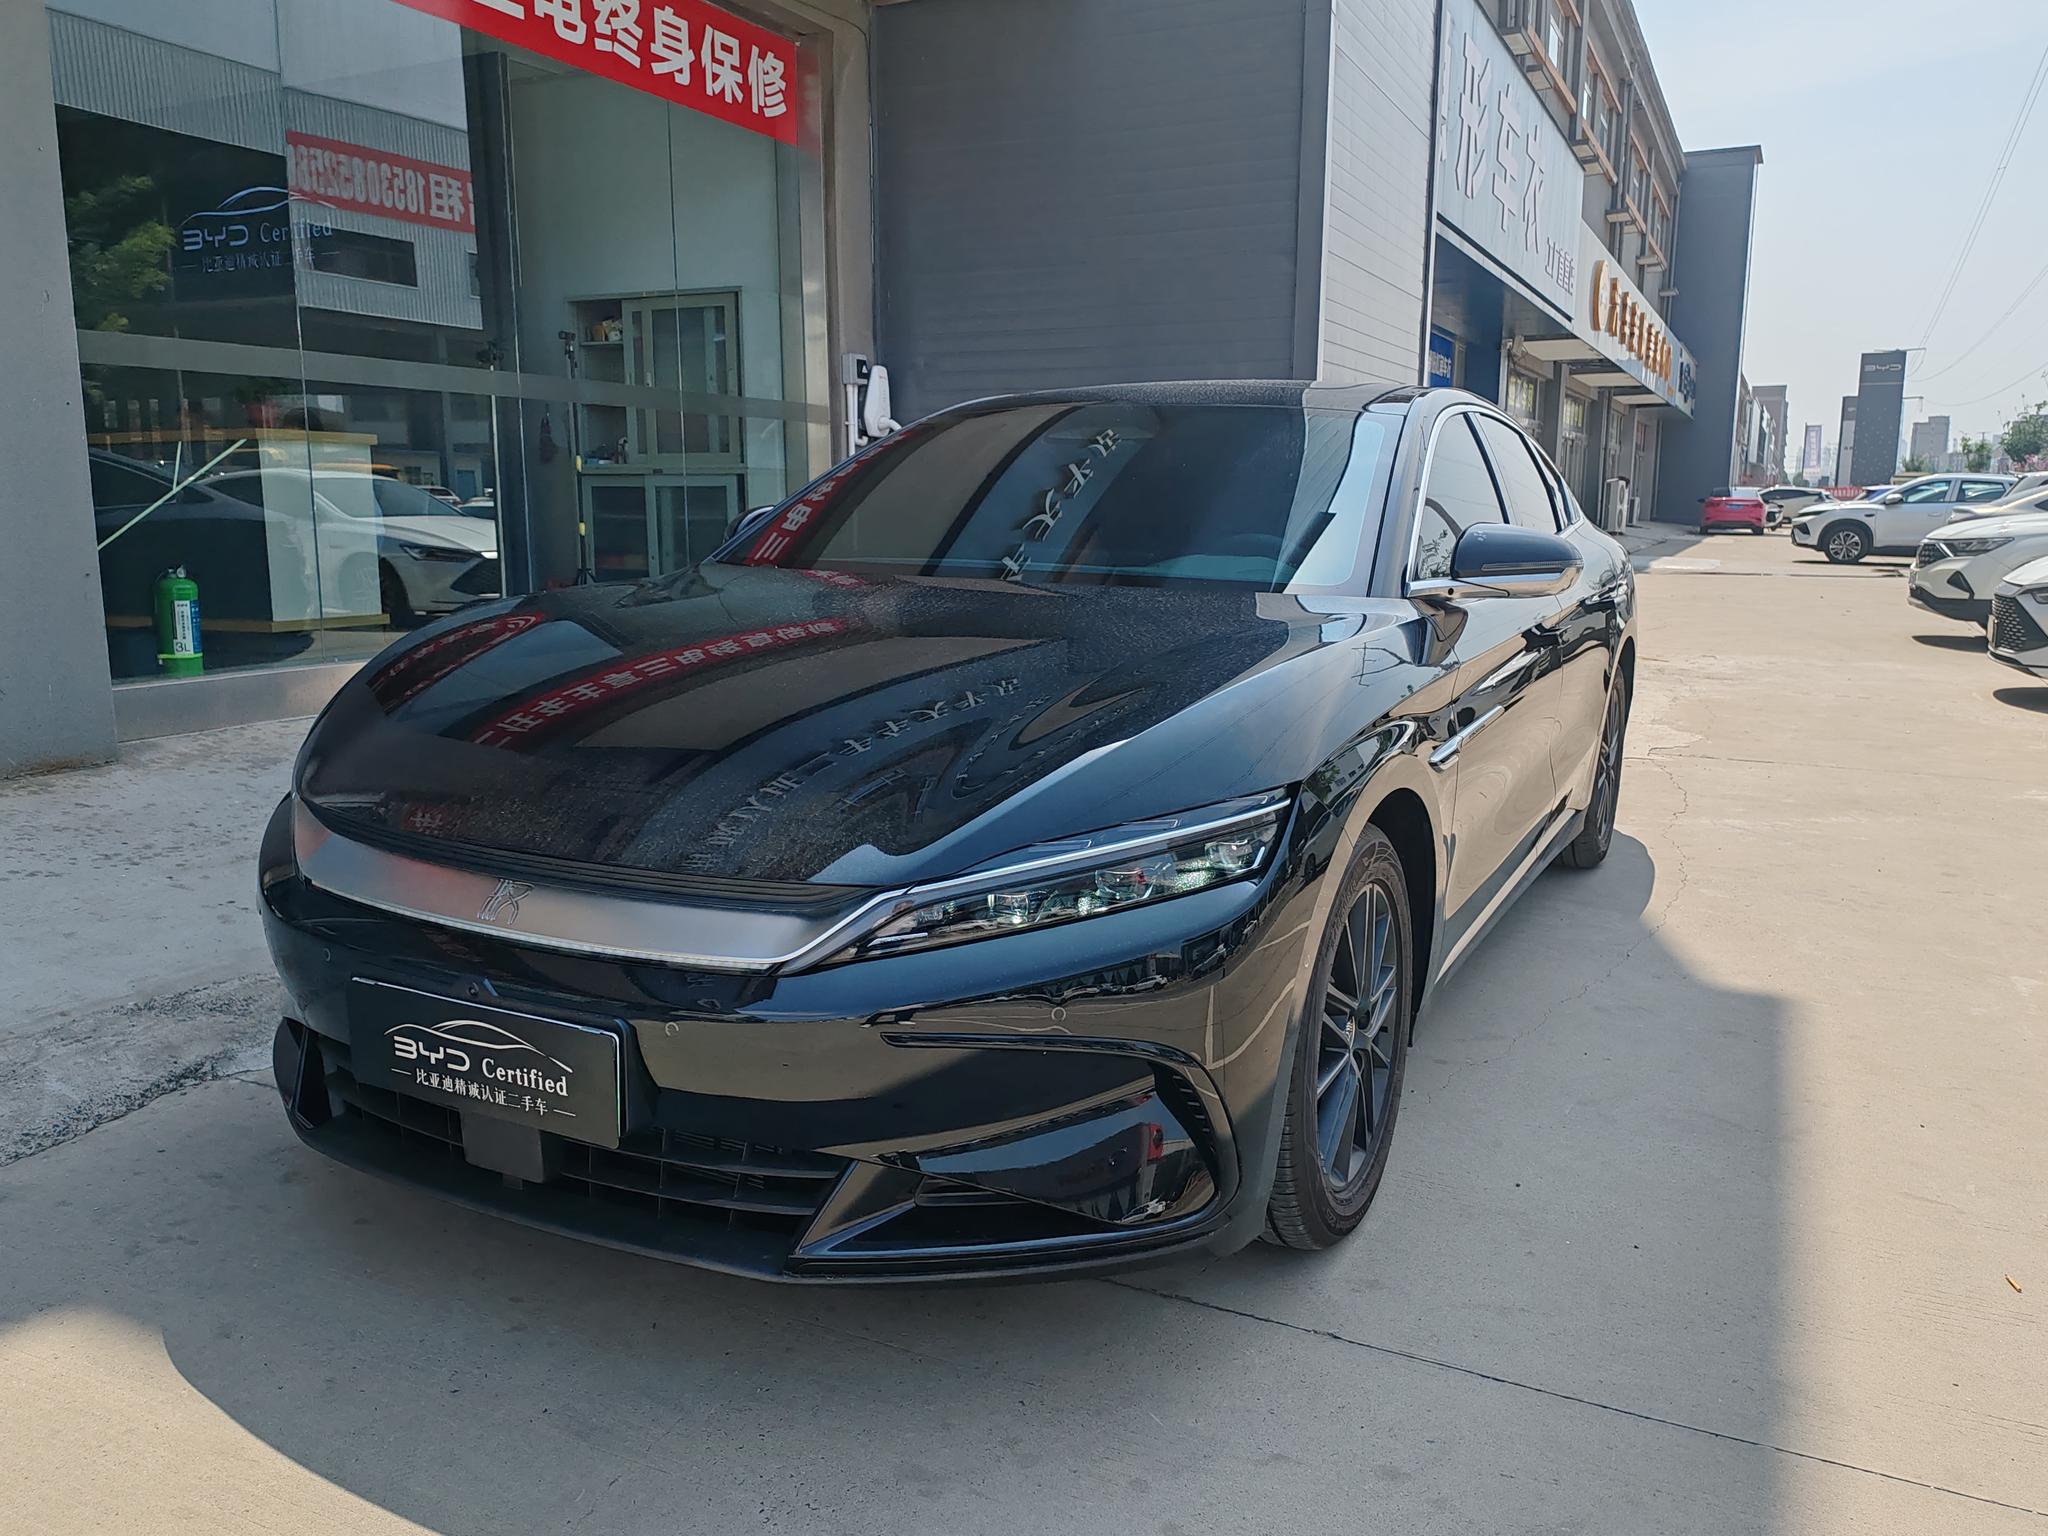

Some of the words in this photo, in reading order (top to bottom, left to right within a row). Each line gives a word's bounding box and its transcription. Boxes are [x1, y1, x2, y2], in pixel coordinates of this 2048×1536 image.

[183, 225, 249, 250] BYD
[260, 217, 333, 243] Cerified
[175, 643, 190, 653] 3L
[393, 1035, 471, 1072] BYD
[481, 1057, 569, 1097] Certified
[415, 1067, 549, 1116] 比亚迪精诚认证二手车
